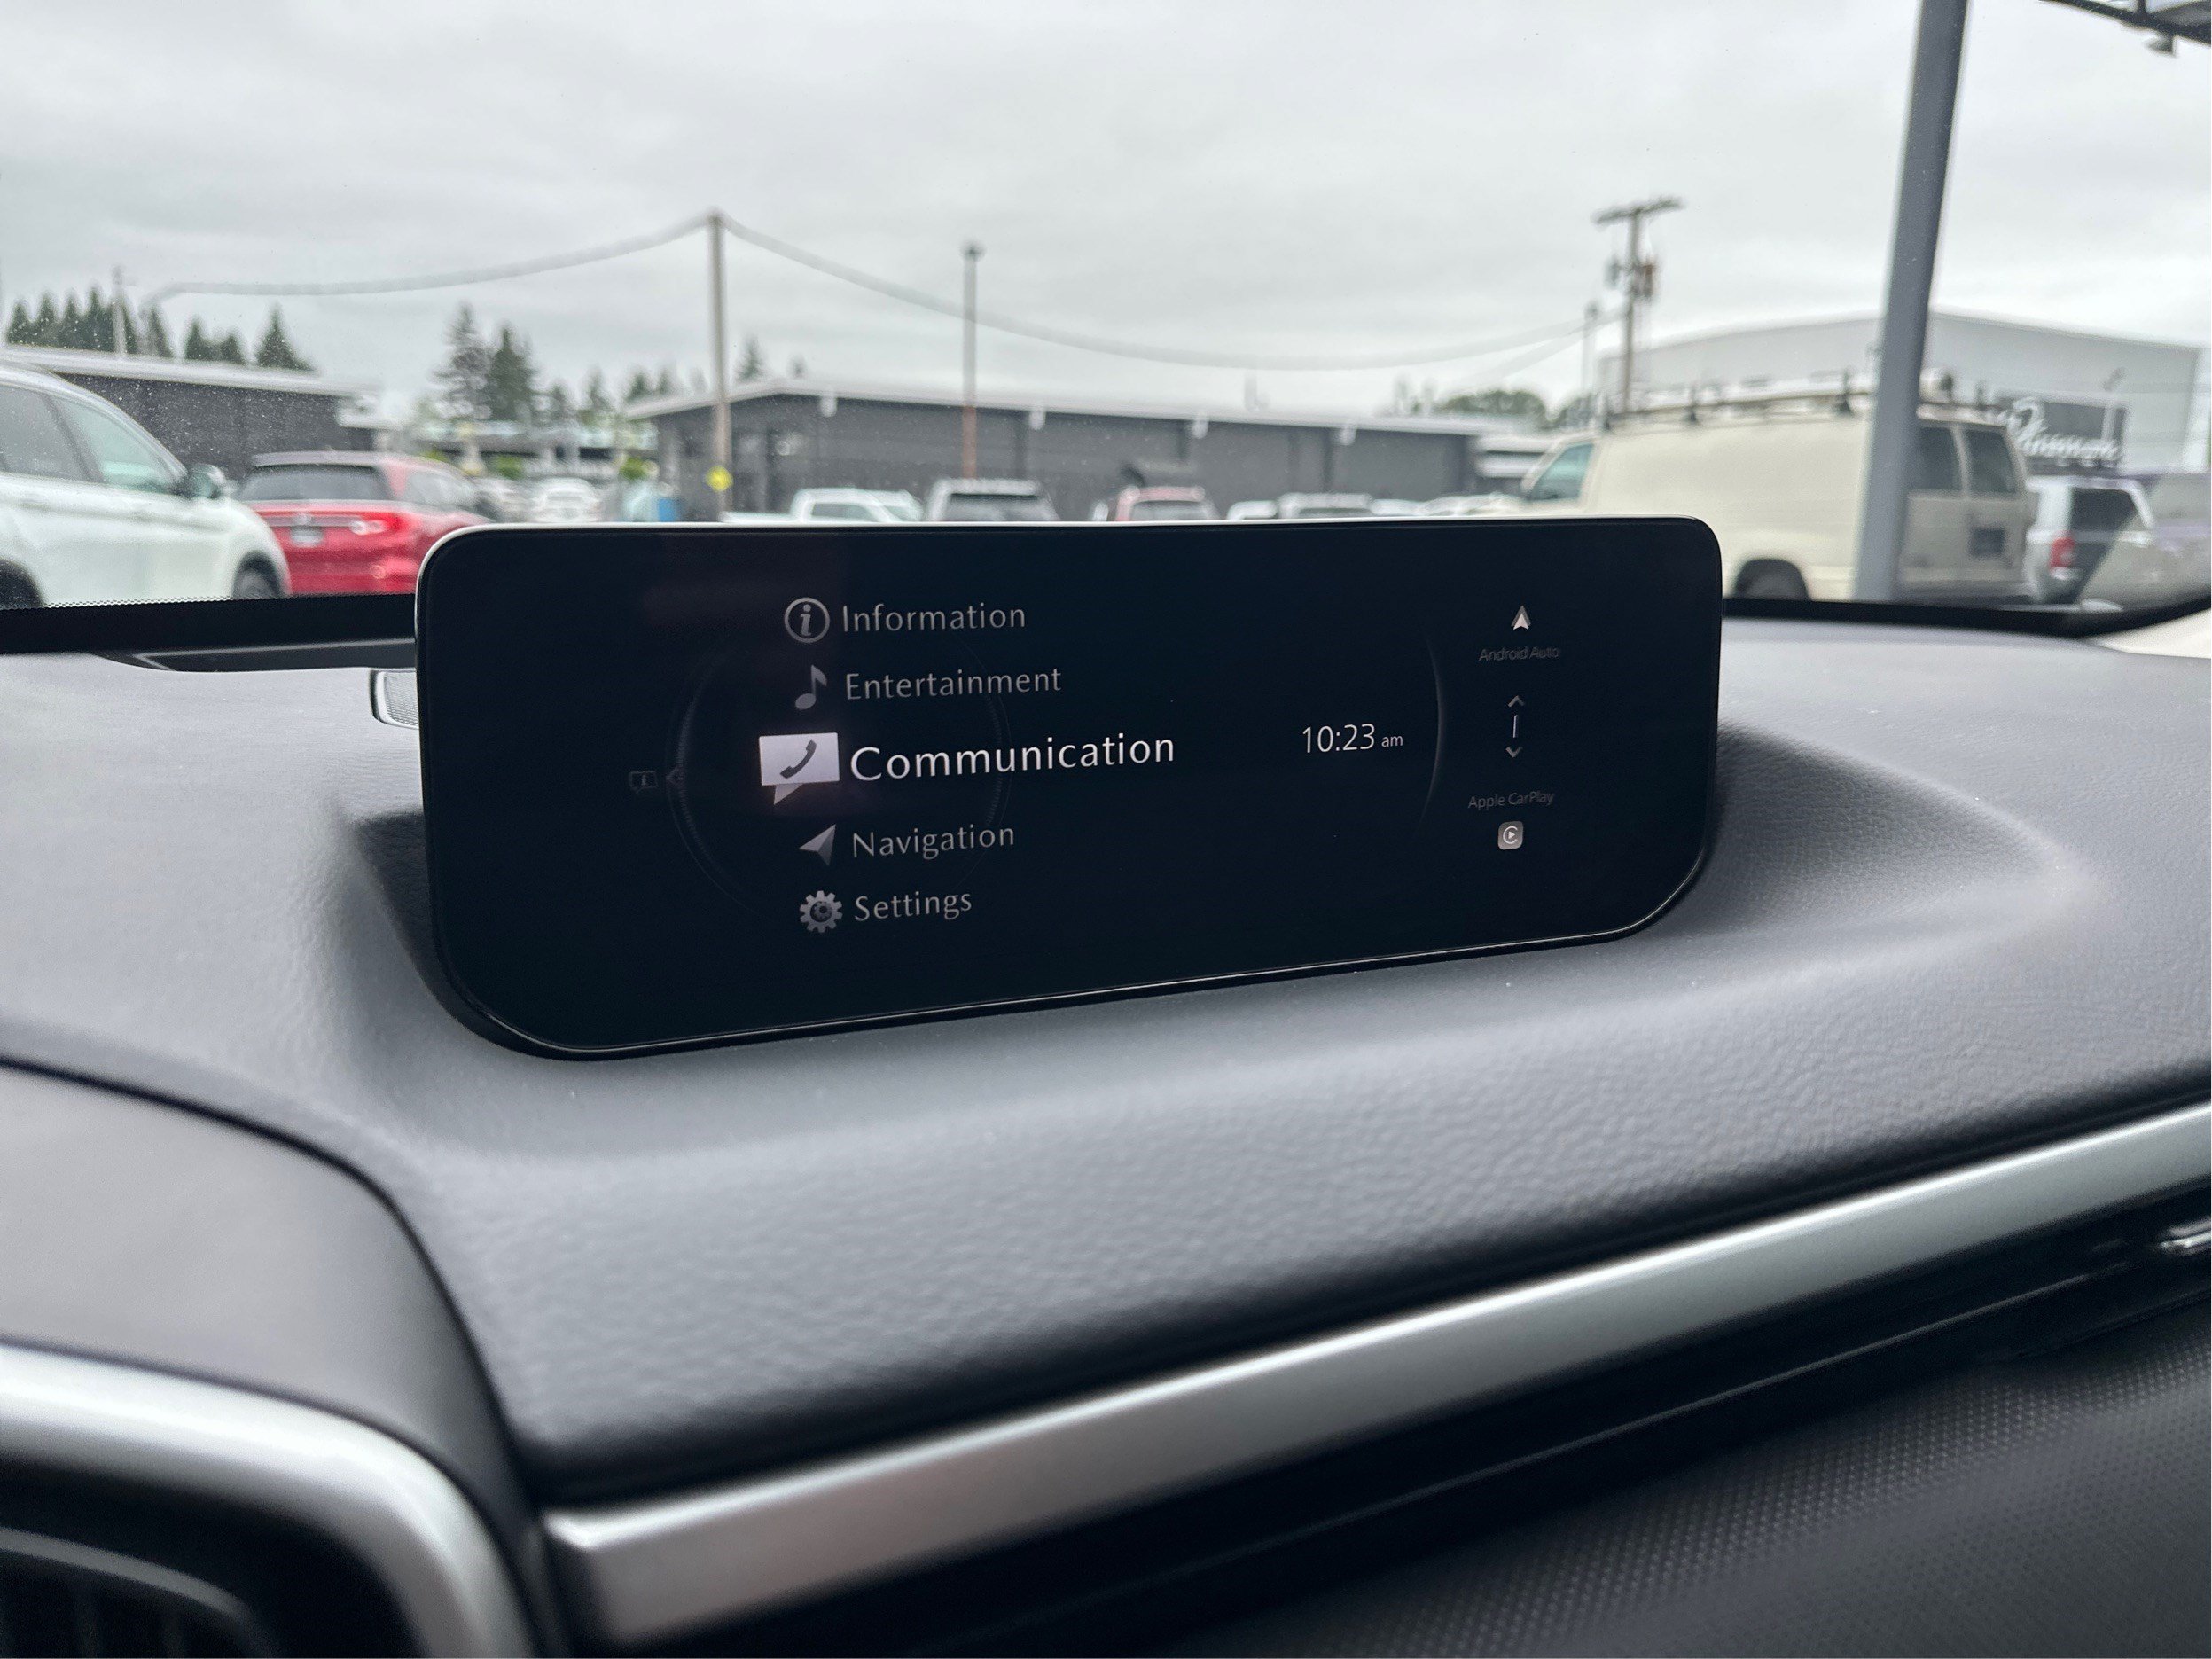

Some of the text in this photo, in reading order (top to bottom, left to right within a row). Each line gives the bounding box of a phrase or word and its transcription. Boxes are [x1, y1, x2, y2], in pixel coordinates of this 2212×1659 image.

[842, 603, 1026, 631] Information
[1479, 646, 1560, 661] Android Auto
[846, 668, 1062, 700] Entertainment
[1301, 723, 1403, 754] 10:23 am
[850, 732, 1175, 781] Communication
[1467, 791, 1554, 810] Apple CarPlay
[852, 824, 1015, 859] Navigation
[855, 891, 973, 921] Settings
